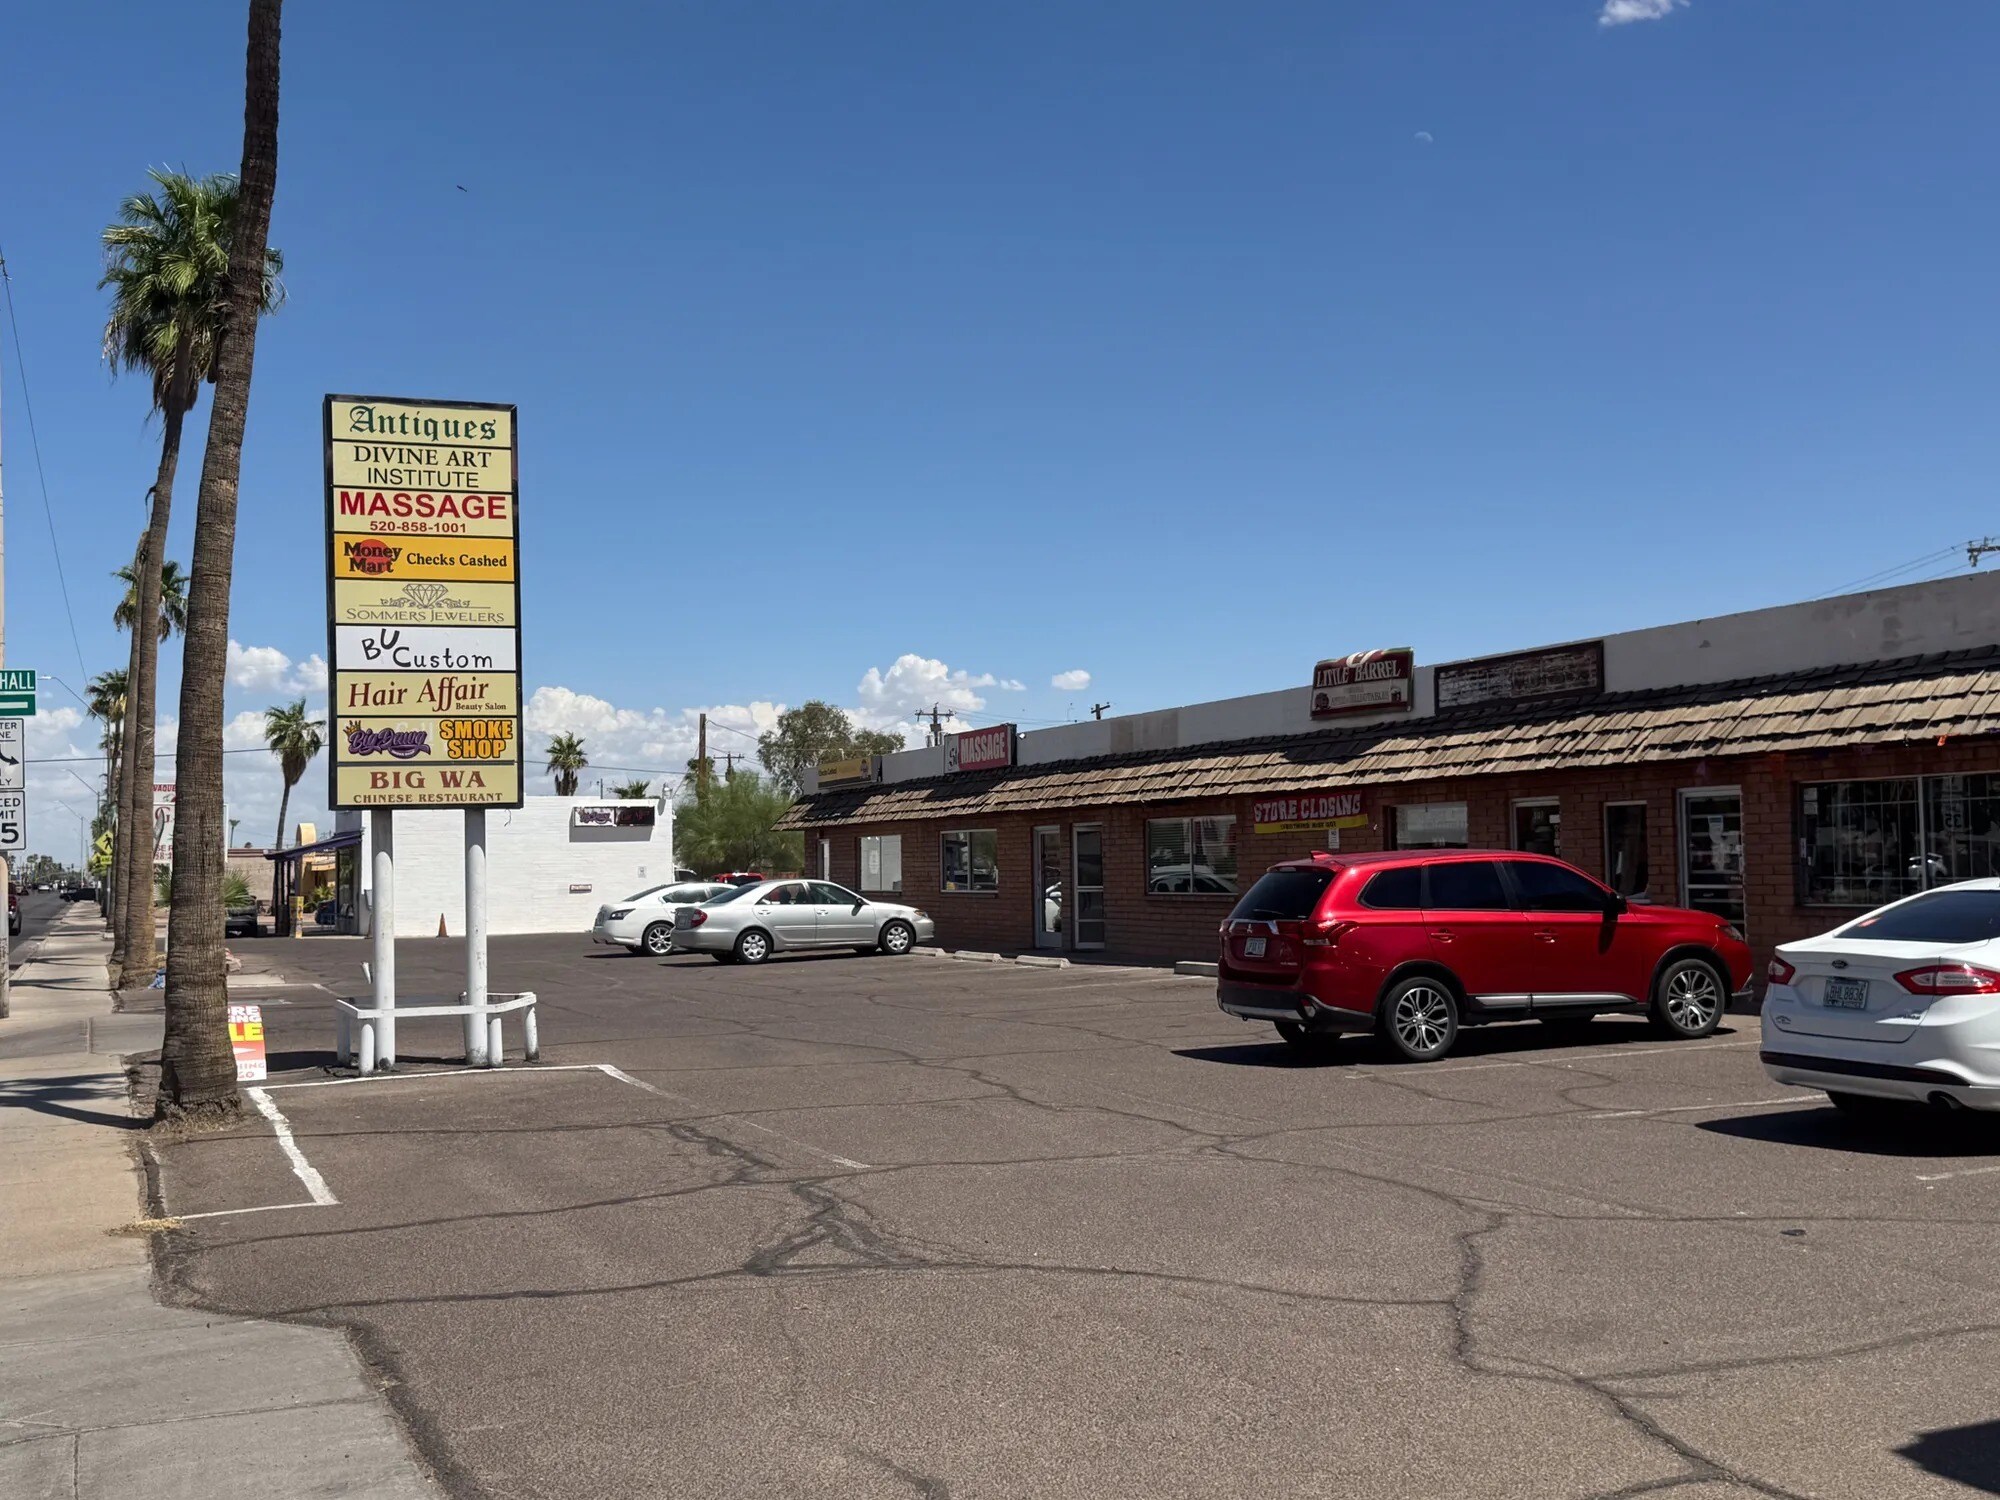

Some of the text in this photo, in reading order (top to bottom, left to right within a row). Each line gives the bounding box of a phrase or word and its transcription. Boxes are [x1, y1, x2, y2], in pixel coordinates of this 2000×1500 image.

[350, 405, 496, 442] Antiques
[354, 446, 491, 468] DIVINE ART
[368, 468, 479, 488] INSTITUTE
[340, 491, 507, 519] MASSAGE
[370, 521, 466, 533] 520-858-1001
[344, 541, 403, 561] Money
[407, 553, 507, 567] Checks Cashed
[349, 557, 394, 573] Mart
[346, 608, 504, 623] SOMMERS JEWELERS
[392, 646, 493, 668] Custom
[1316, 660, 1400, 688] LITTLE BARREL
[348, 676, 489, 712] Hair Affair
[456, 702, 506, 712] Beauty Salon
[439, 719, 513, 740] SMOKE
[448, 739, 506, 759] SHOP
[961, 732, 1006, 765] MASSAGE
[370, 770, 486, 790] BIG WA
[353, 793, 503, 804] CHINESE RESTAURANT
[1254, 793, 1361, 822] STORE CLOSING
[1, 822, 20, 844] 5
[228, 1006, 261, 1016] RE
